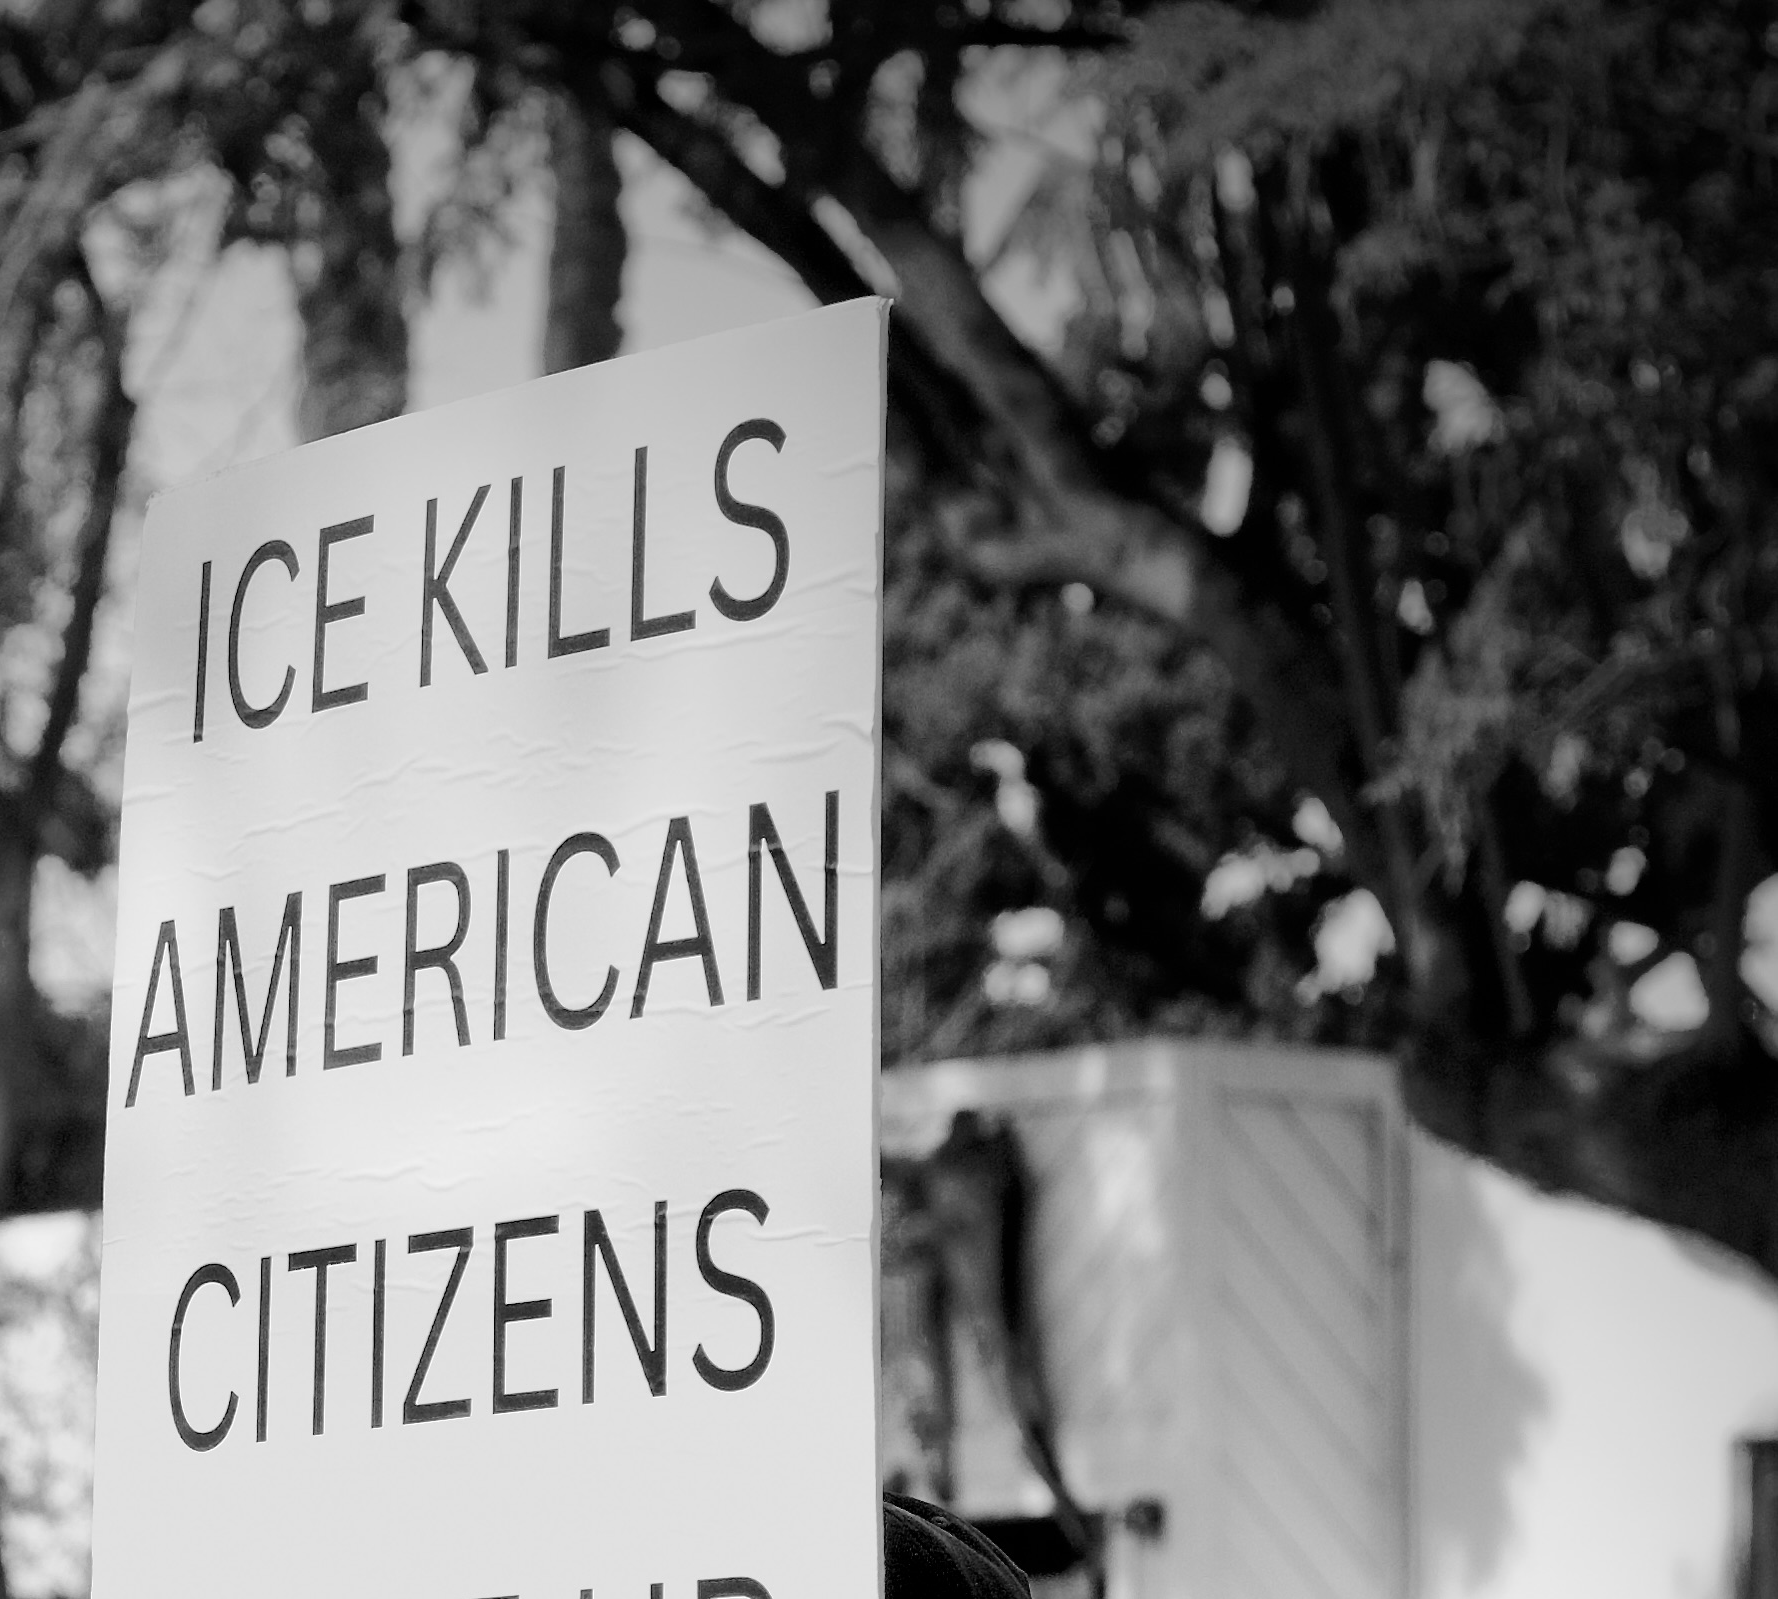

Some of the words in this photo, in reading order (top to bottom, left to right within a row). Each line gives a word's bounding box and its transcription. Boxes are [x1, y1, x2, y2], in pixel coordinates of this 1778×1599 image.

[192, 515, 375, 743] ICE
[420, 418, 789, 687] KILLS
[125, 791, 838, 1106] AMERICAN
[168, 1189, 774, 1452] CITIZENS
